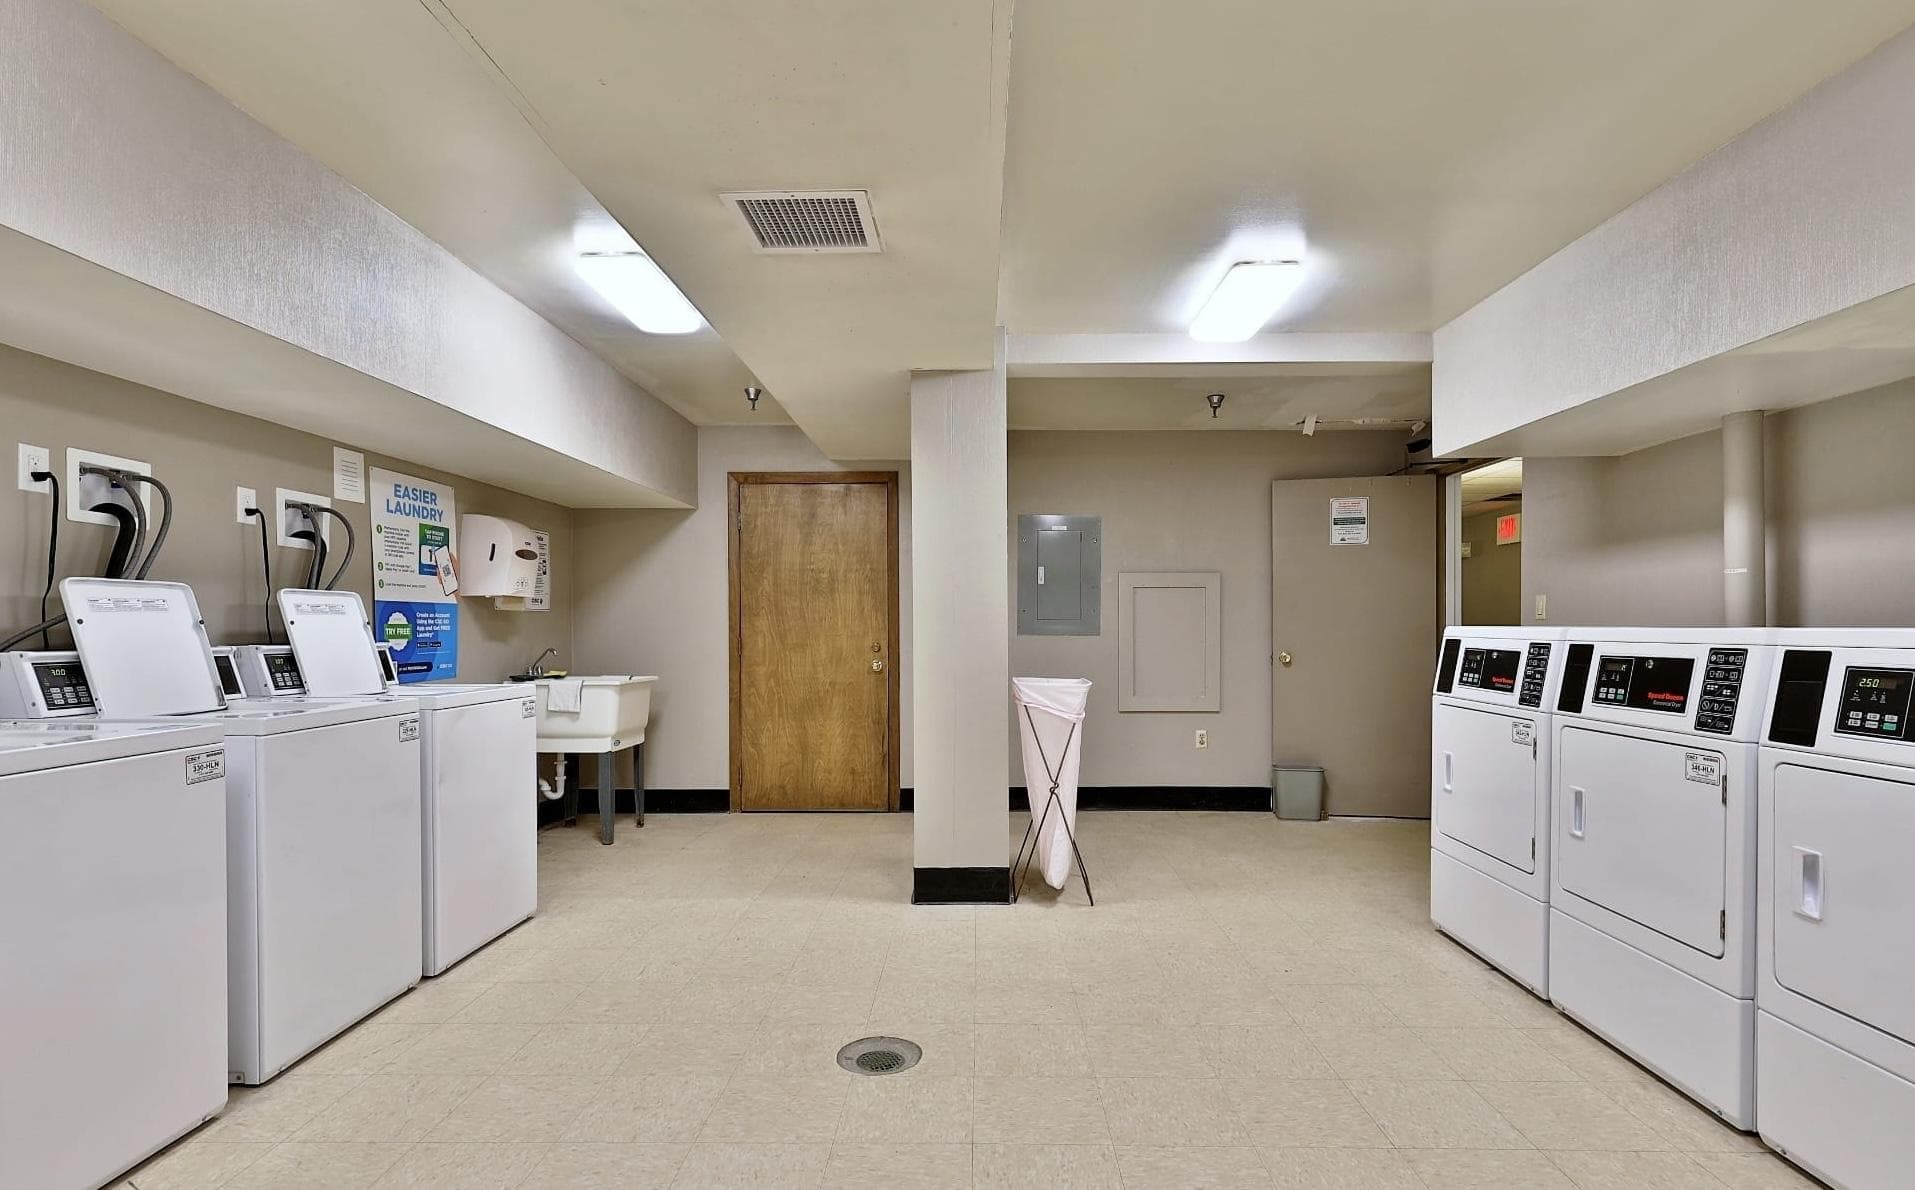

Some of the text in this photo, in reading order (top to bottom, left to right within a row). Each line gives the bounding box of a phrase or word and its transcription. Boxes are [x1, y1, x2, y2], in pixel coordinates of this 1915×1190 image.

[394, 484, 437, 506] EASIER
[386, 498, 444, 522] LAUNDRY
[1648, 692, 1666, 700] Speed
